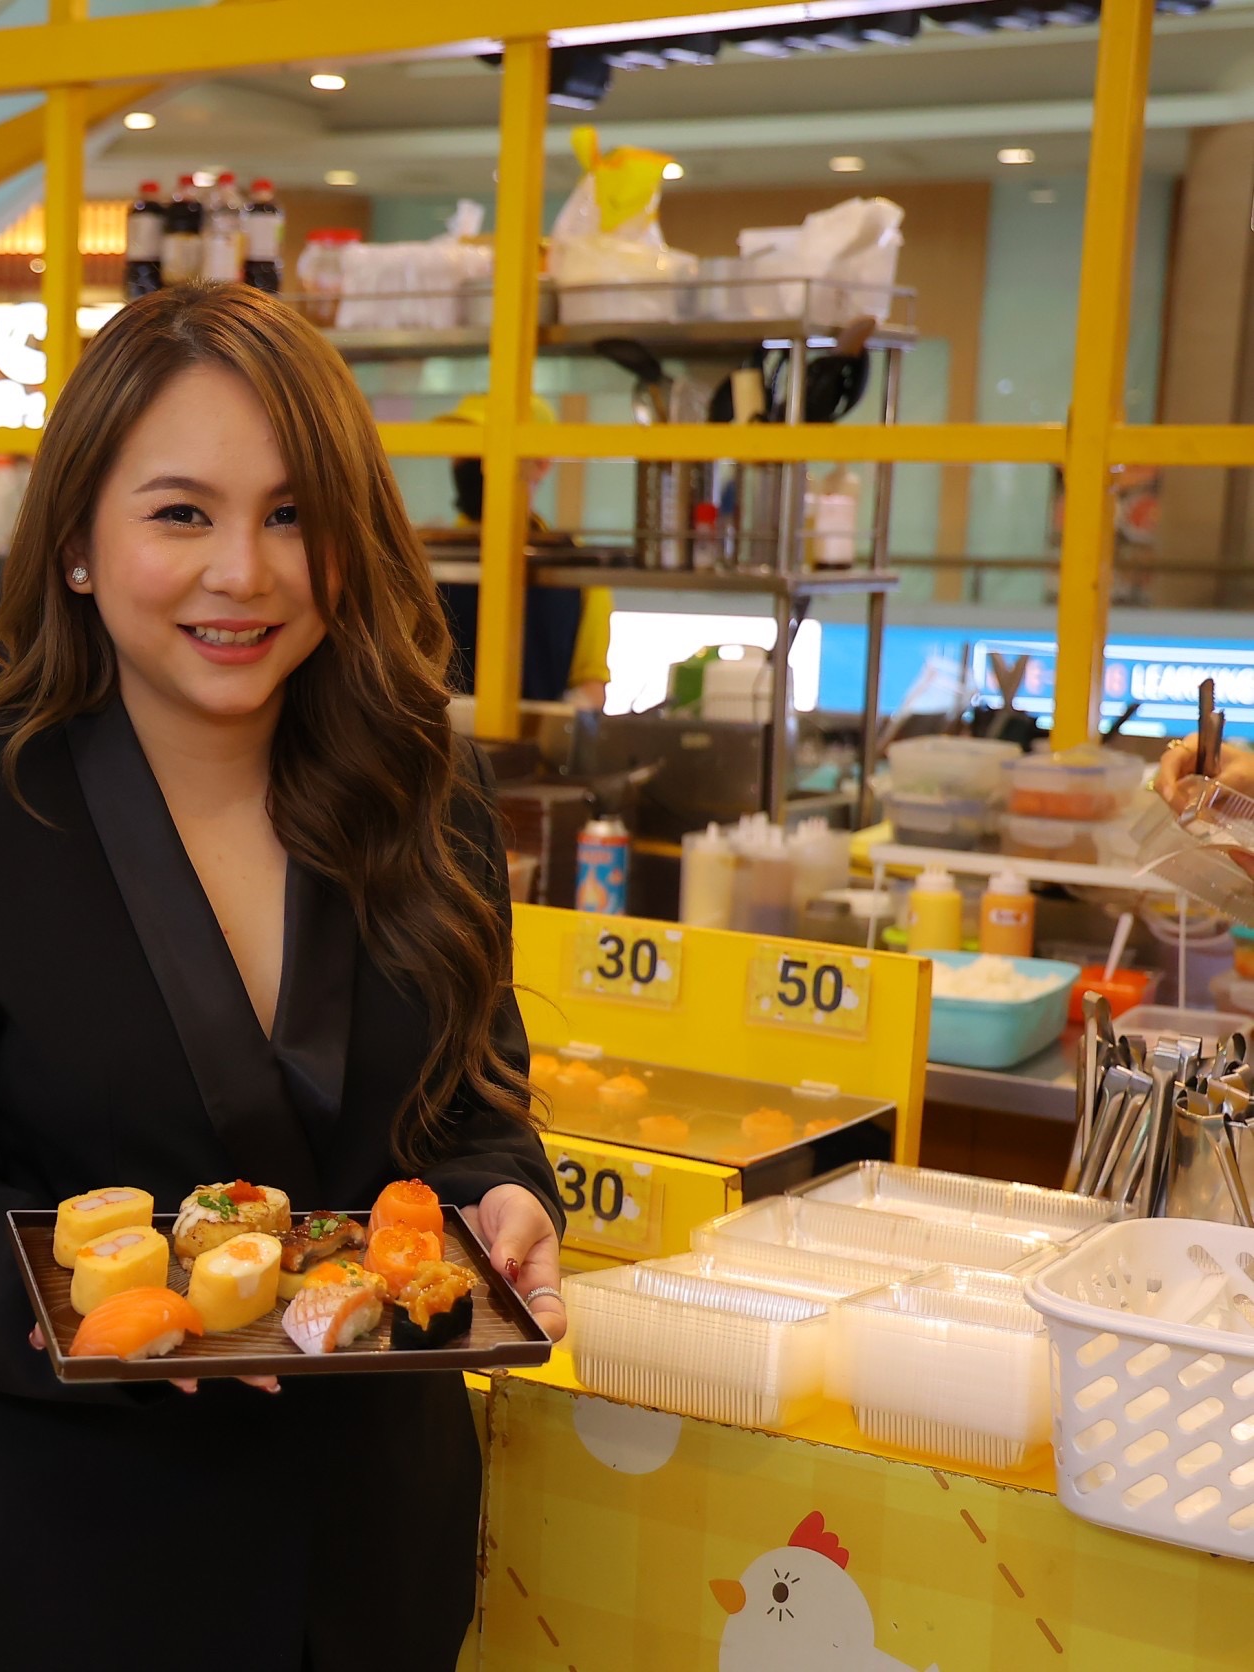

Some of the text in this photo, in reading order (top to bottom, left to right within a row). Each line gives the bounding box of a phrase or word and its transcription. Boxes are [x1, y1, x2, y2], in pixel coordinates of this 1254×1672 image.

[596, 935, 658, 985] 30
[777, 959, 844, 1013] 50
[557, 1160, 625, 1222] 30
